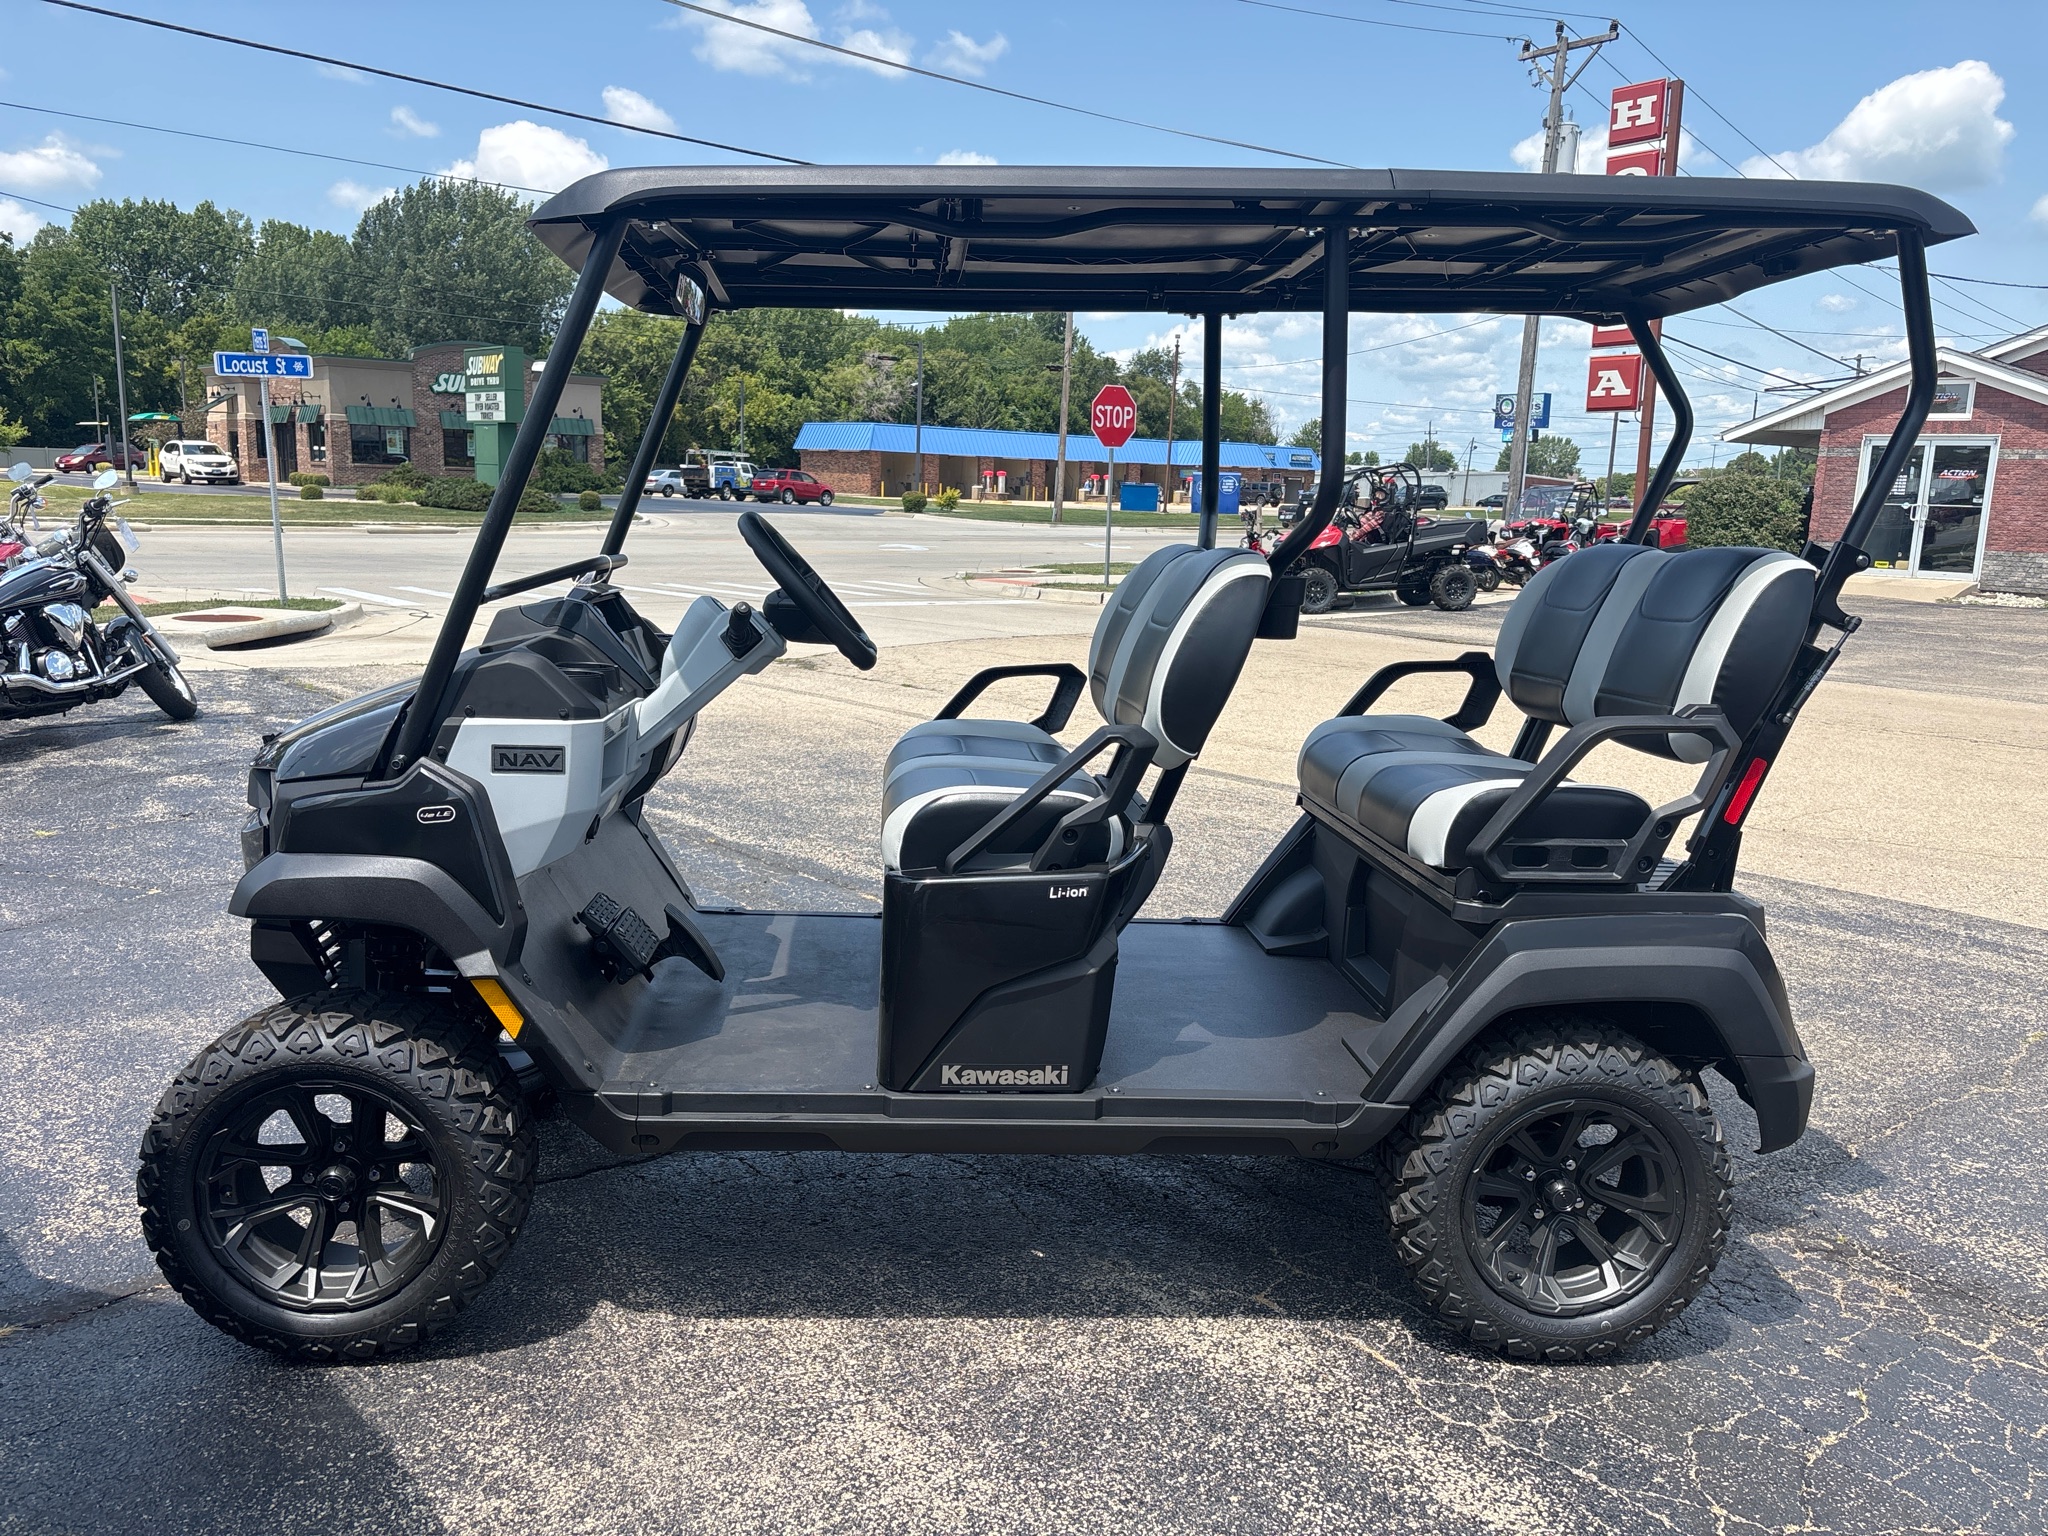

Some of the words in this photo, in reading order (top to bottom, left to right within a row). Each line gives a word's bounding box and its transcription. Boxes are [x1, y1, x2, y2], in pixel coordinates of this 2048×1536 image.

[222, 355, 269, 374] Locust
[275, 357, 287, 375] St
[465, 353, 504, 376] SUBWAY
[470, 377, 485, 387] DRIVE
[486, 376, 500, 386] THRU
[1095, 405, 1133, 429] STOP
[1940, 469, 1978, 477] ACTION
[499, 752, 561, 768] NAV
[436, 810, 452, 818] LE
[1049, 886, 1088, 899] Li-ion
[941, 1065, 1069, 1086] Kawasaki
